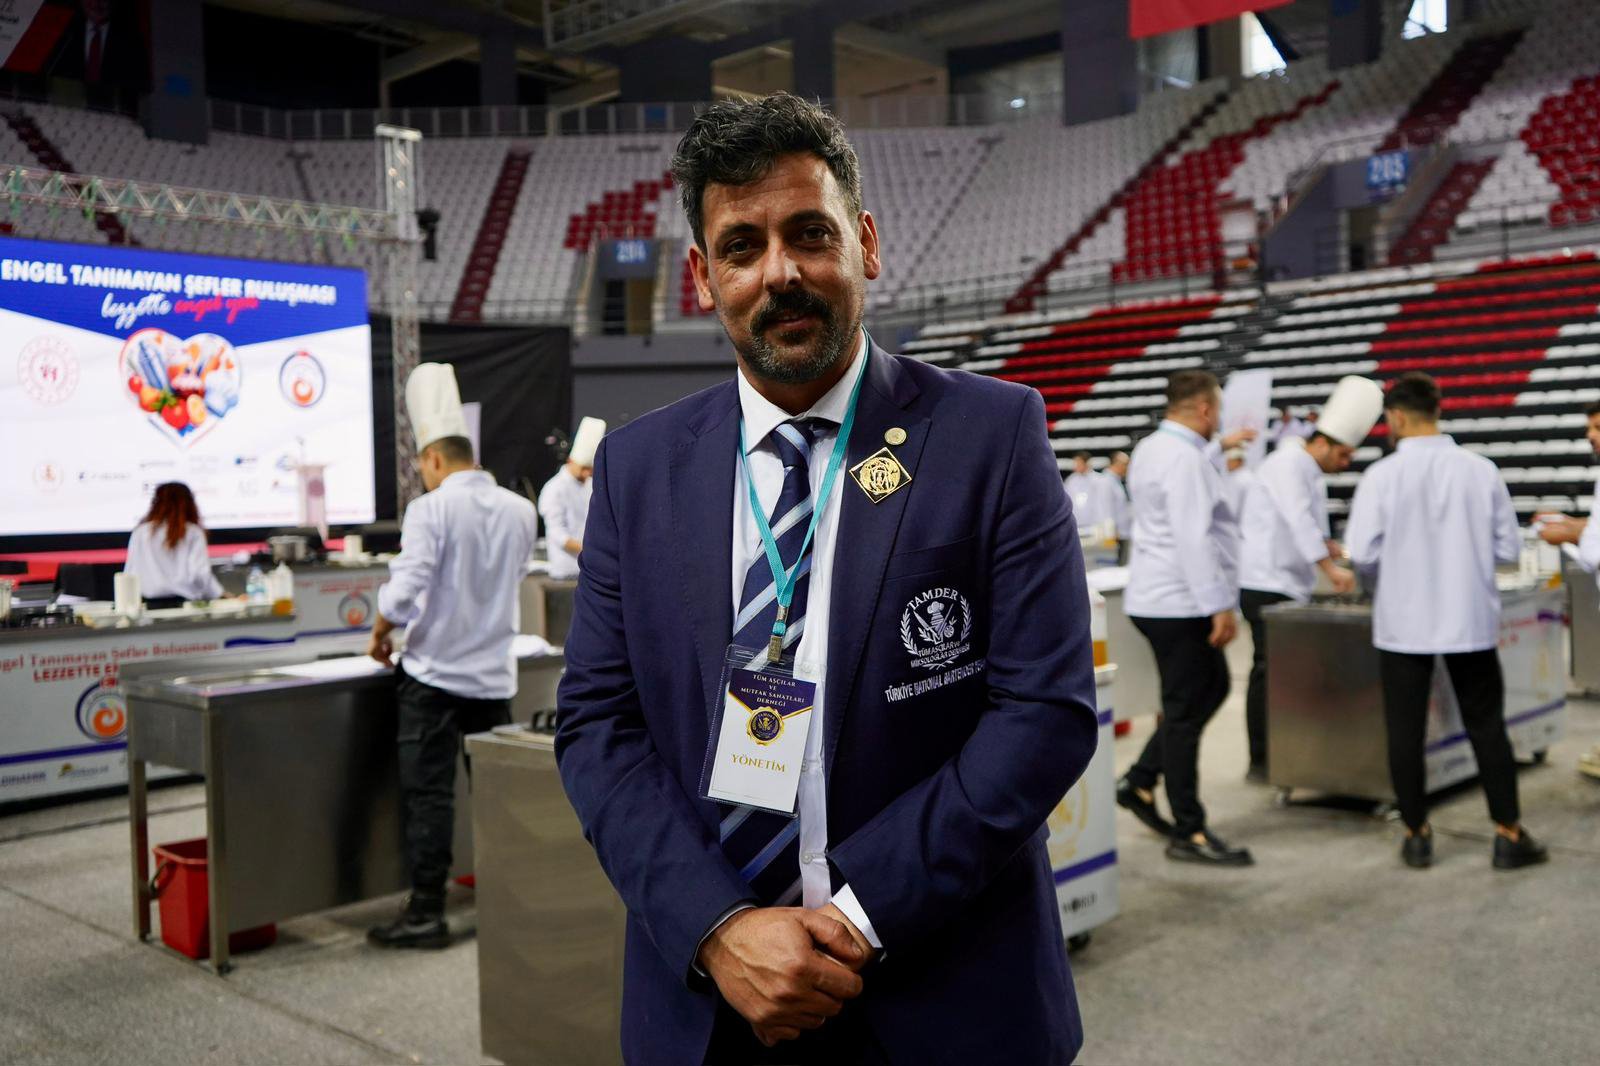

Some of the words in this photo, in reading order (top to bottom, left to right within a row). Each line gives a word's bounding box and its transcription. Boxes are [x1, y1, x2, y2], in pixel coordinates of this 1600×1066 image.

[1, 258, 68, 285] ENGEL
[69, 264, 182, 293] TANIMAYAN
[184, 274, 243, 299] ŞEFLER
[244, 278, 337, 307] BULUŞMASI
[907, 587, 958, 610] TAMDER
[33, 664, 100, 683] LEZZETTE
[741, 687, 767, 697] MUTFAK
[885, 682, 914, 703] TÜRKİYE
[914, 674, 943, 696] NATIONAL
[731, 753, 785, 773] YÖNETİM
